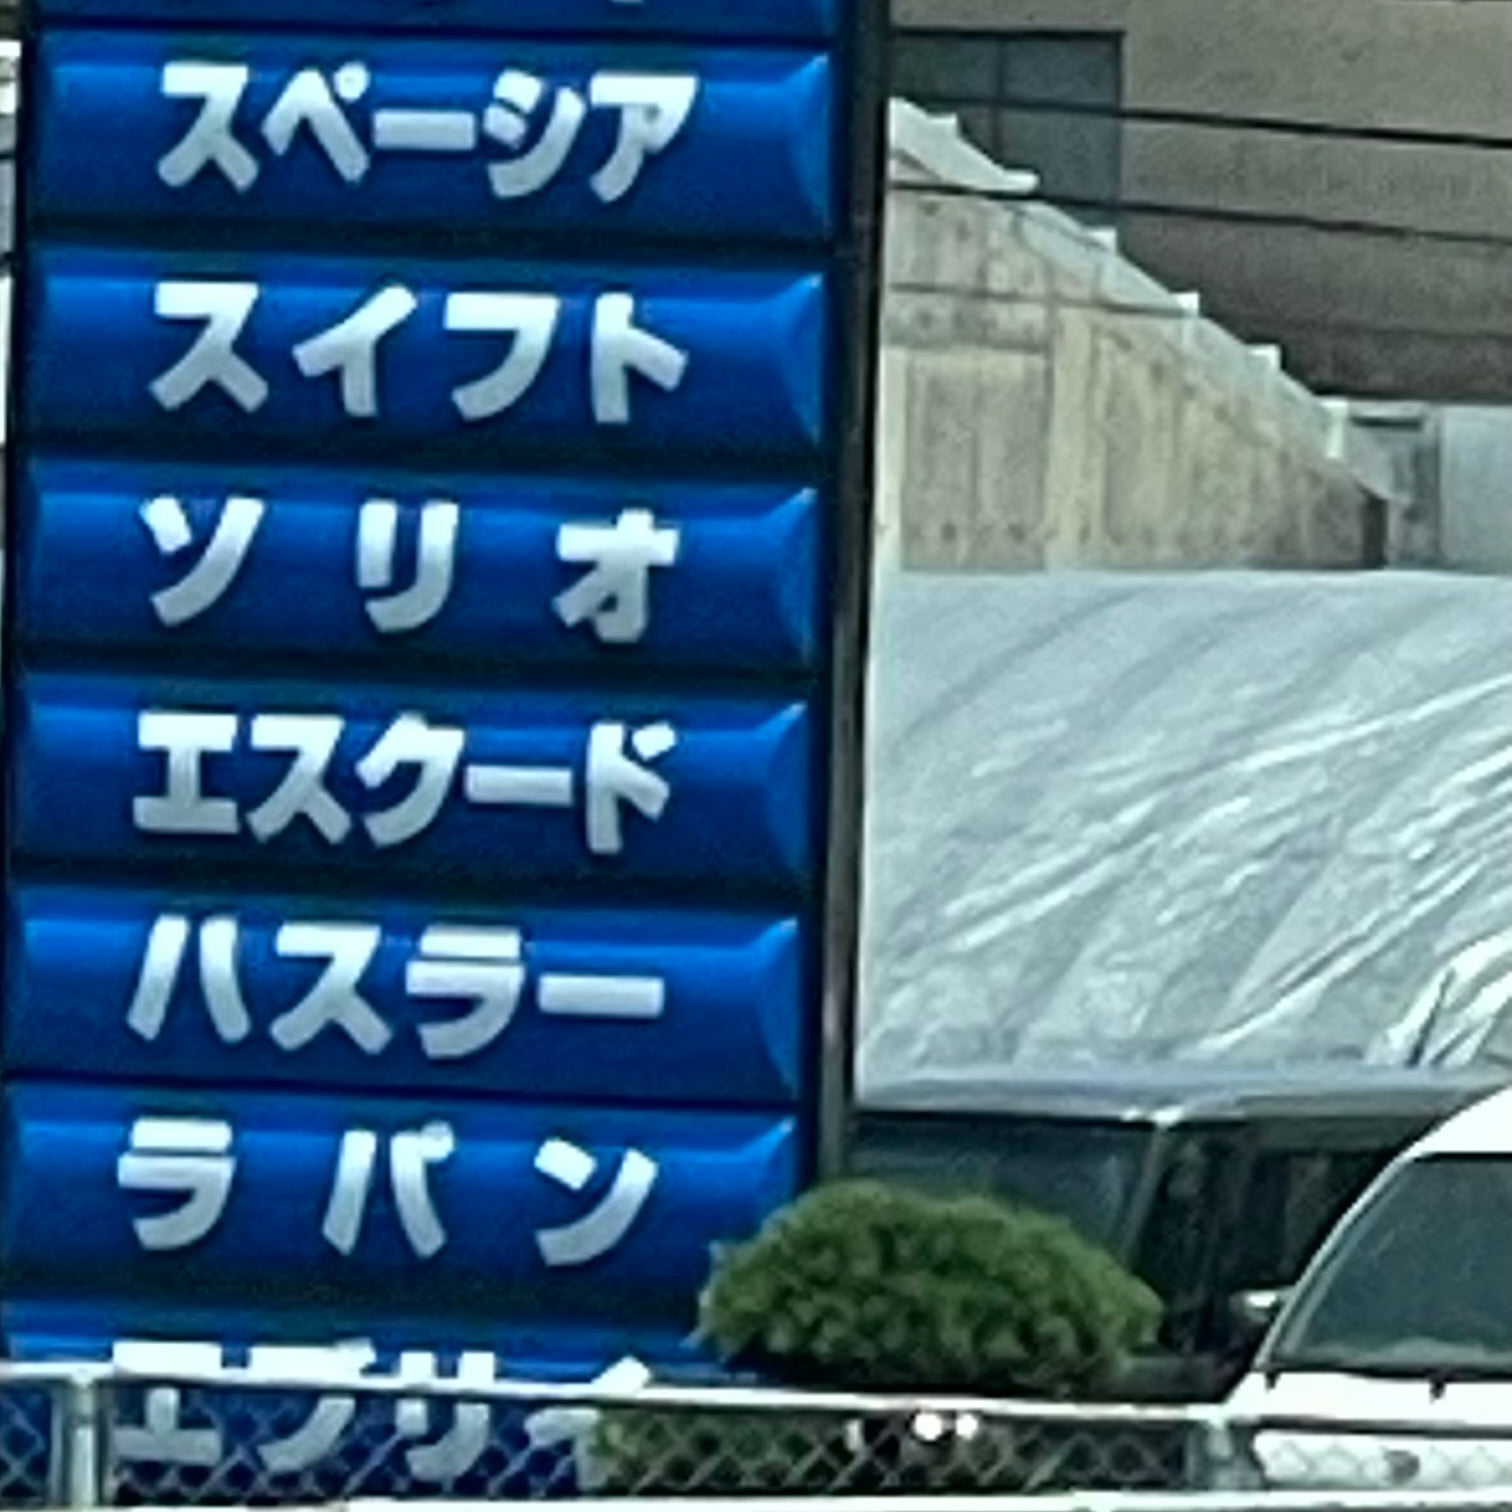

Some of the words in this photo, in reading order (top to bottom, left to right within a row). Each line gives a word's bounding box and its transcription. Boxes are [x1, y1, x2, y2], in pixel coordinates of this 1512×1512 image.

[156, 60, 699, 204] スペーシア
[148, 281, 688, 426] スイフト
[138, 495, 681, 643] ソリオ
[132, 712, 678, 856] エスクード
[125, 913, 666, 1061] ハスラー
[116, 1116, 660, 1268] ラパン
